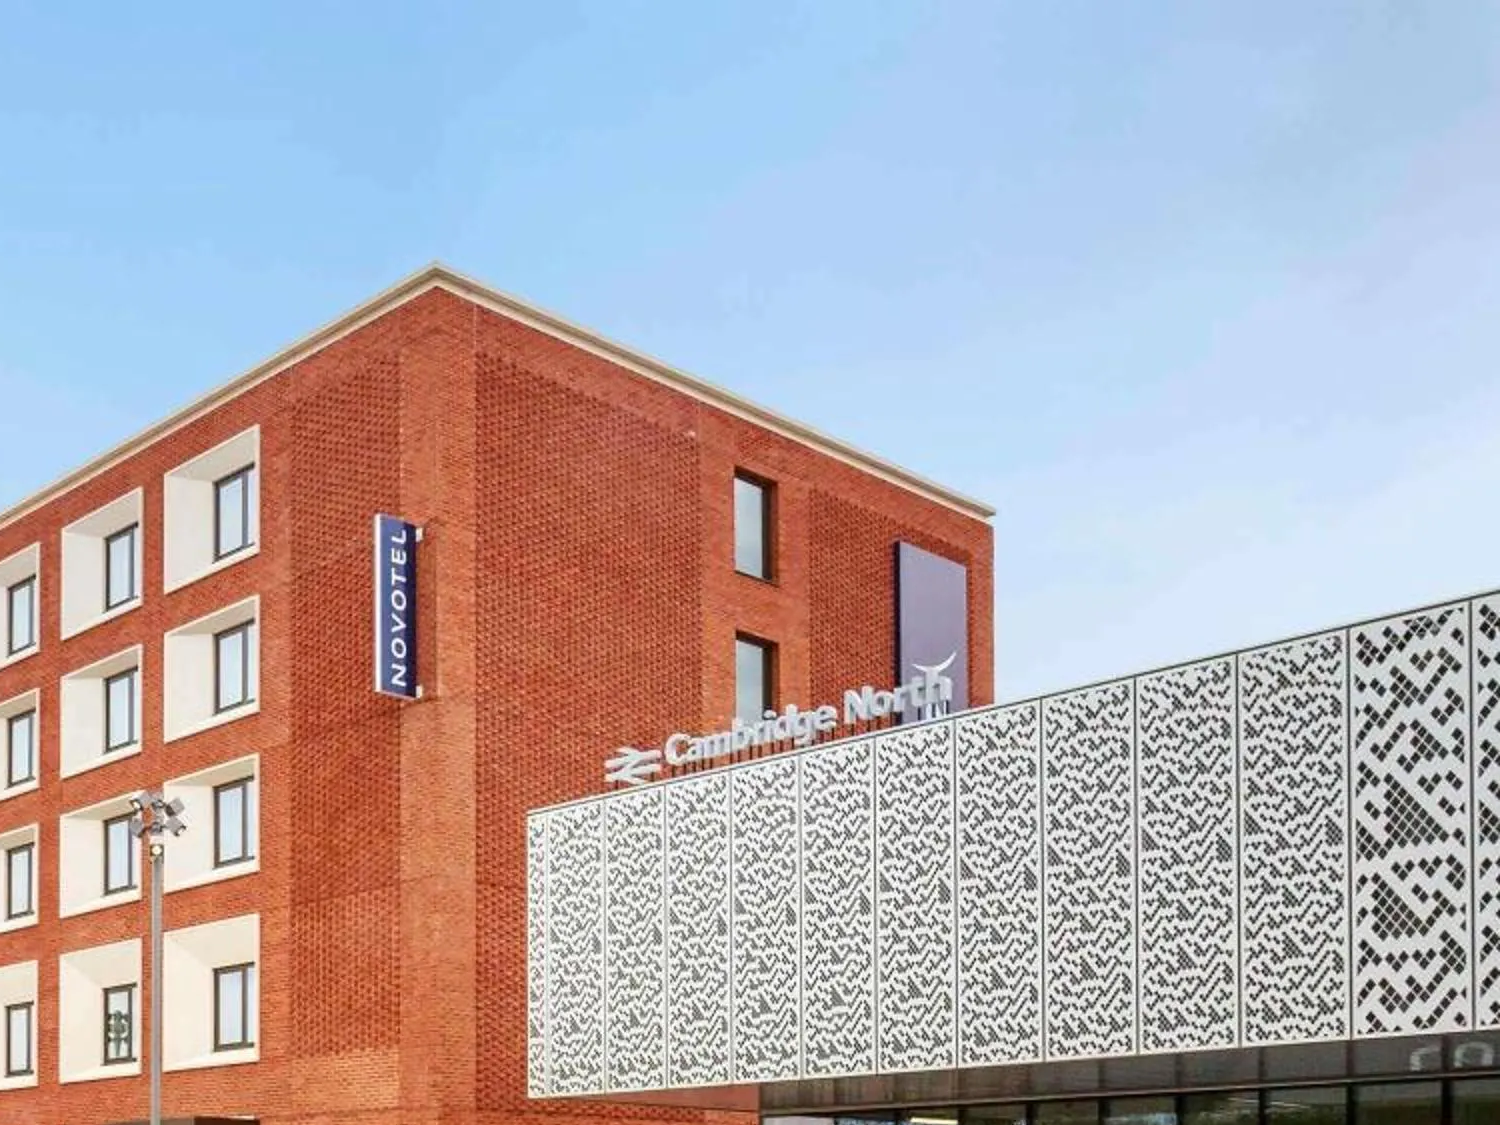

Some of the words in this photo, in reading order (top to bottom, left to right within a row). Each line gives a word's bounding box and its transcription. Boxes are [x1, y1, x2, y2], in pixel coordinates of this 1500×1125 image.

[391, 529, 407, 687] NOVOTEL
[665, 702, 838, 765] Cambridge
[844, 668, 953, 723] North
